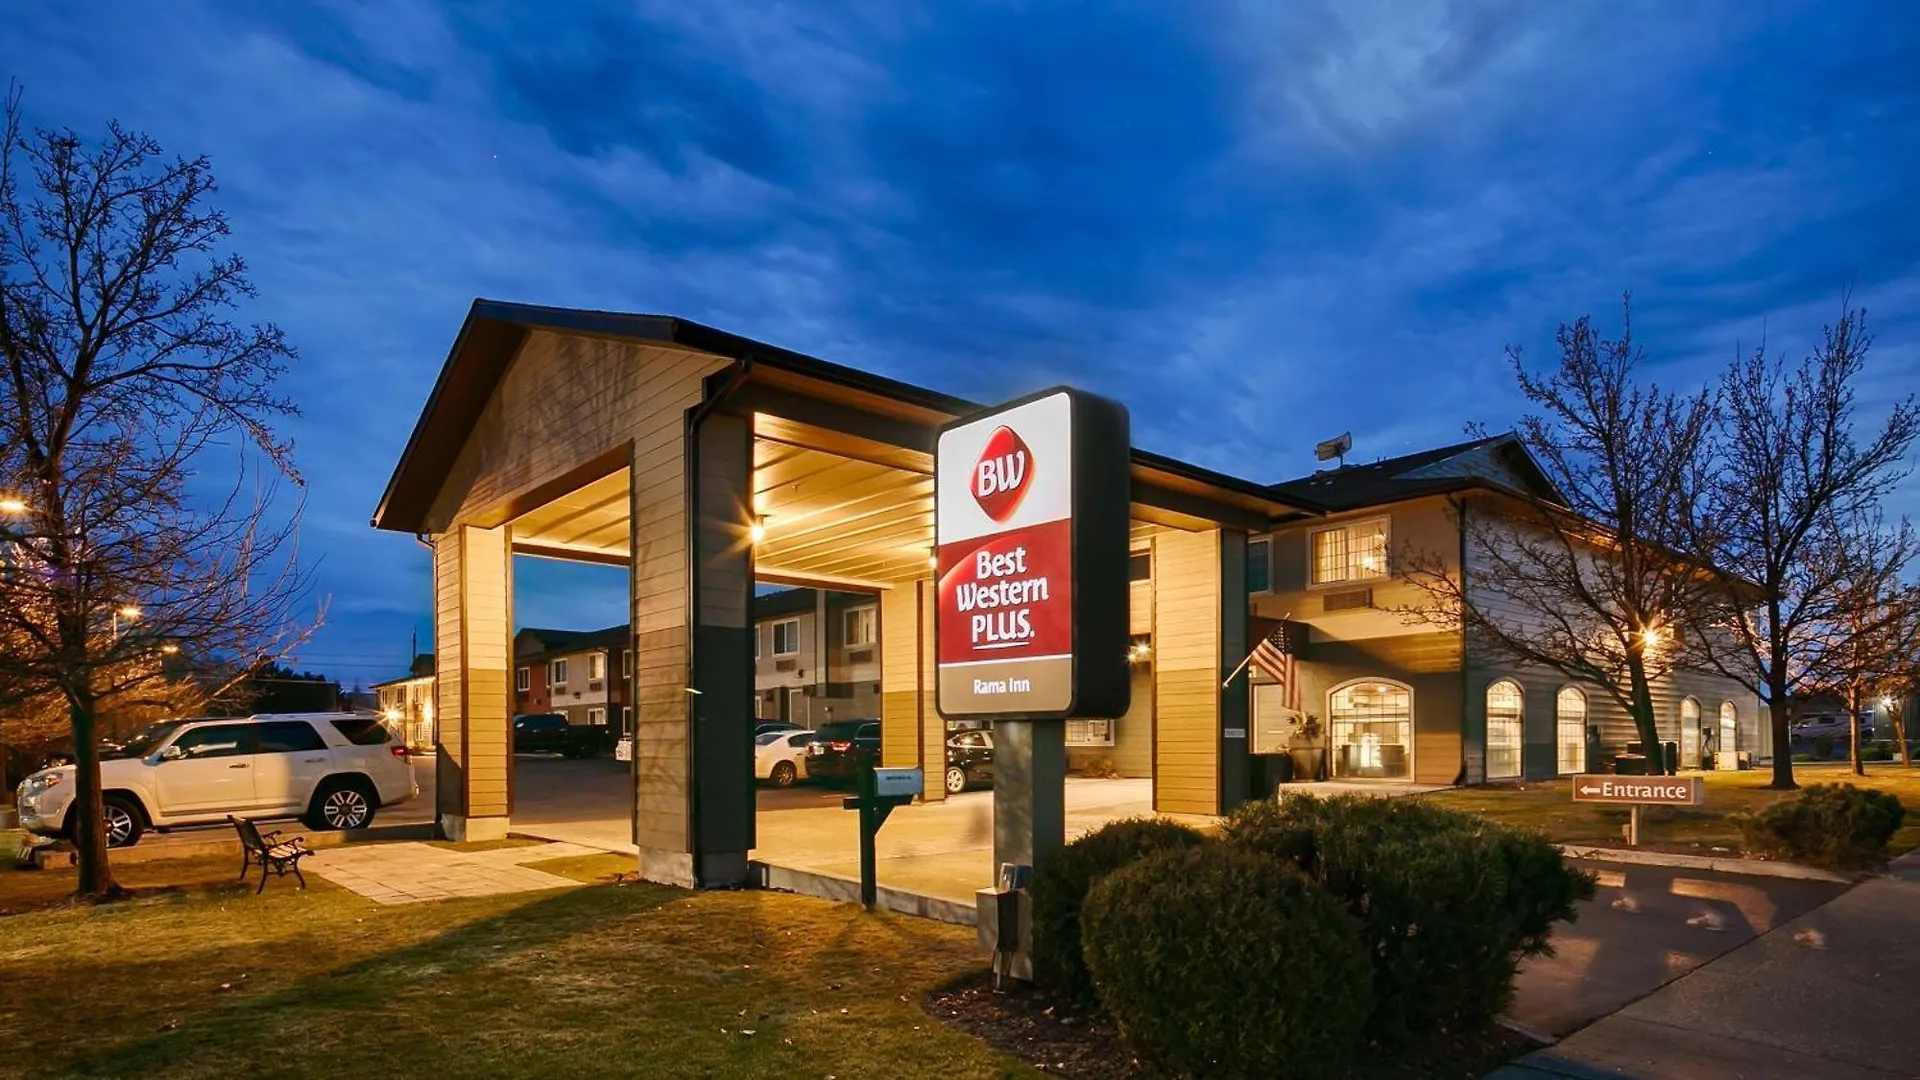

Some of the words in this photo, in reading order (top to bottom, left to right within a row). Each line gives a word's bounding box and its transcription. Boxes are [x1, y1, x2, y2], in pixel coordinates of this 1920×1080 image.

[978, 450, 1025, 497] BW
[976, 546, 1027, 579] Best
[956, 576, 1049, 612] Western
[973, 679, 1007, 694] Rama
[1009, 678, 1030, 693] Inn
[1602, 782, 1687, 799] Entrance
